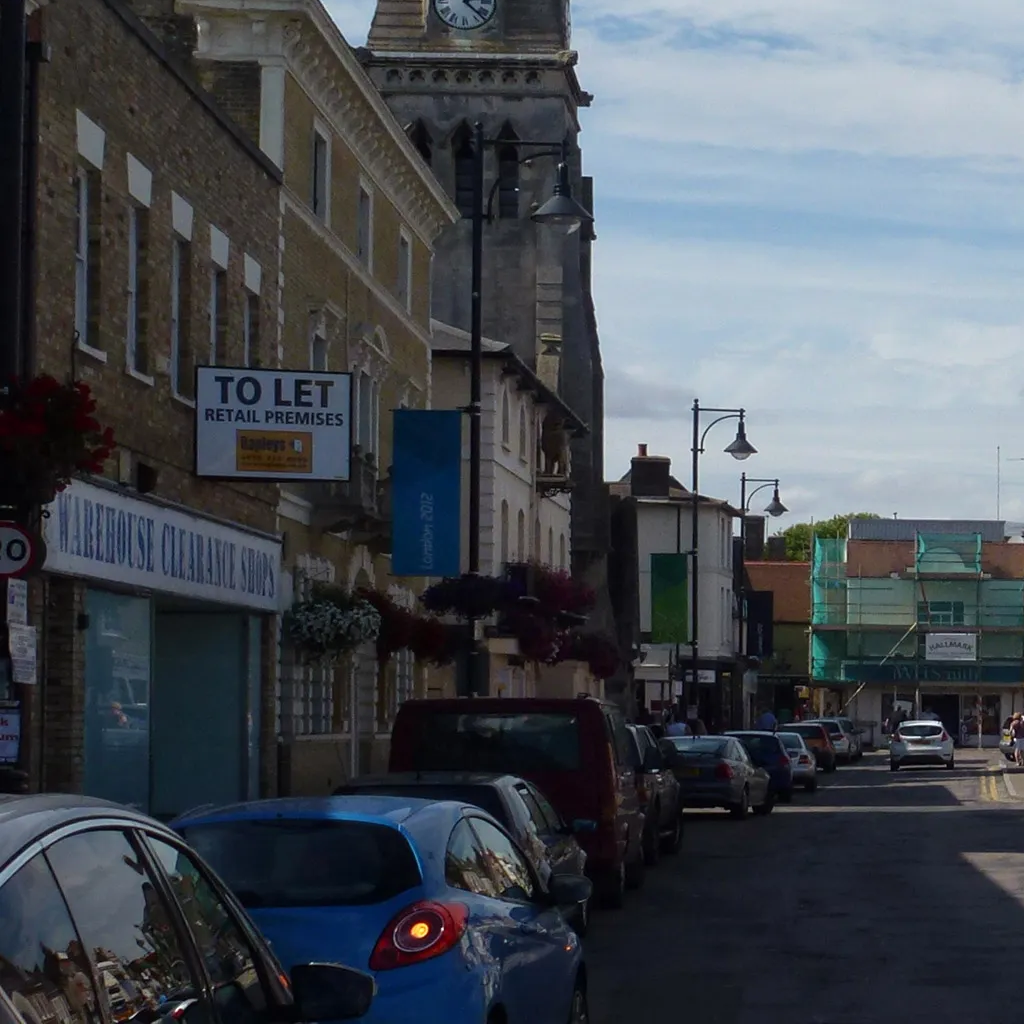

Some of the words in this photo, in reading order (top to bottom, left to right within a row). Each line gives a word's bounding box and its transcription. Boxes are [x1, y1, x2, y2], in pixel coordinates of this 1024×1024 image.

[214, 375, 262, 405] TO
[274, 378, 335, 408] LET
[205, 408, 260, 423] RETAIL
[265, 410, 344, 426] PREMISES
[0, 539, 25, 561] 0
[57, 492, 154, 573] WAREHOUSE
[161, 523, 236, 591] CLEARANCE
[241, 545, 275, 599] SHOPS
[928, 641, 974, 652] HALLMARK
